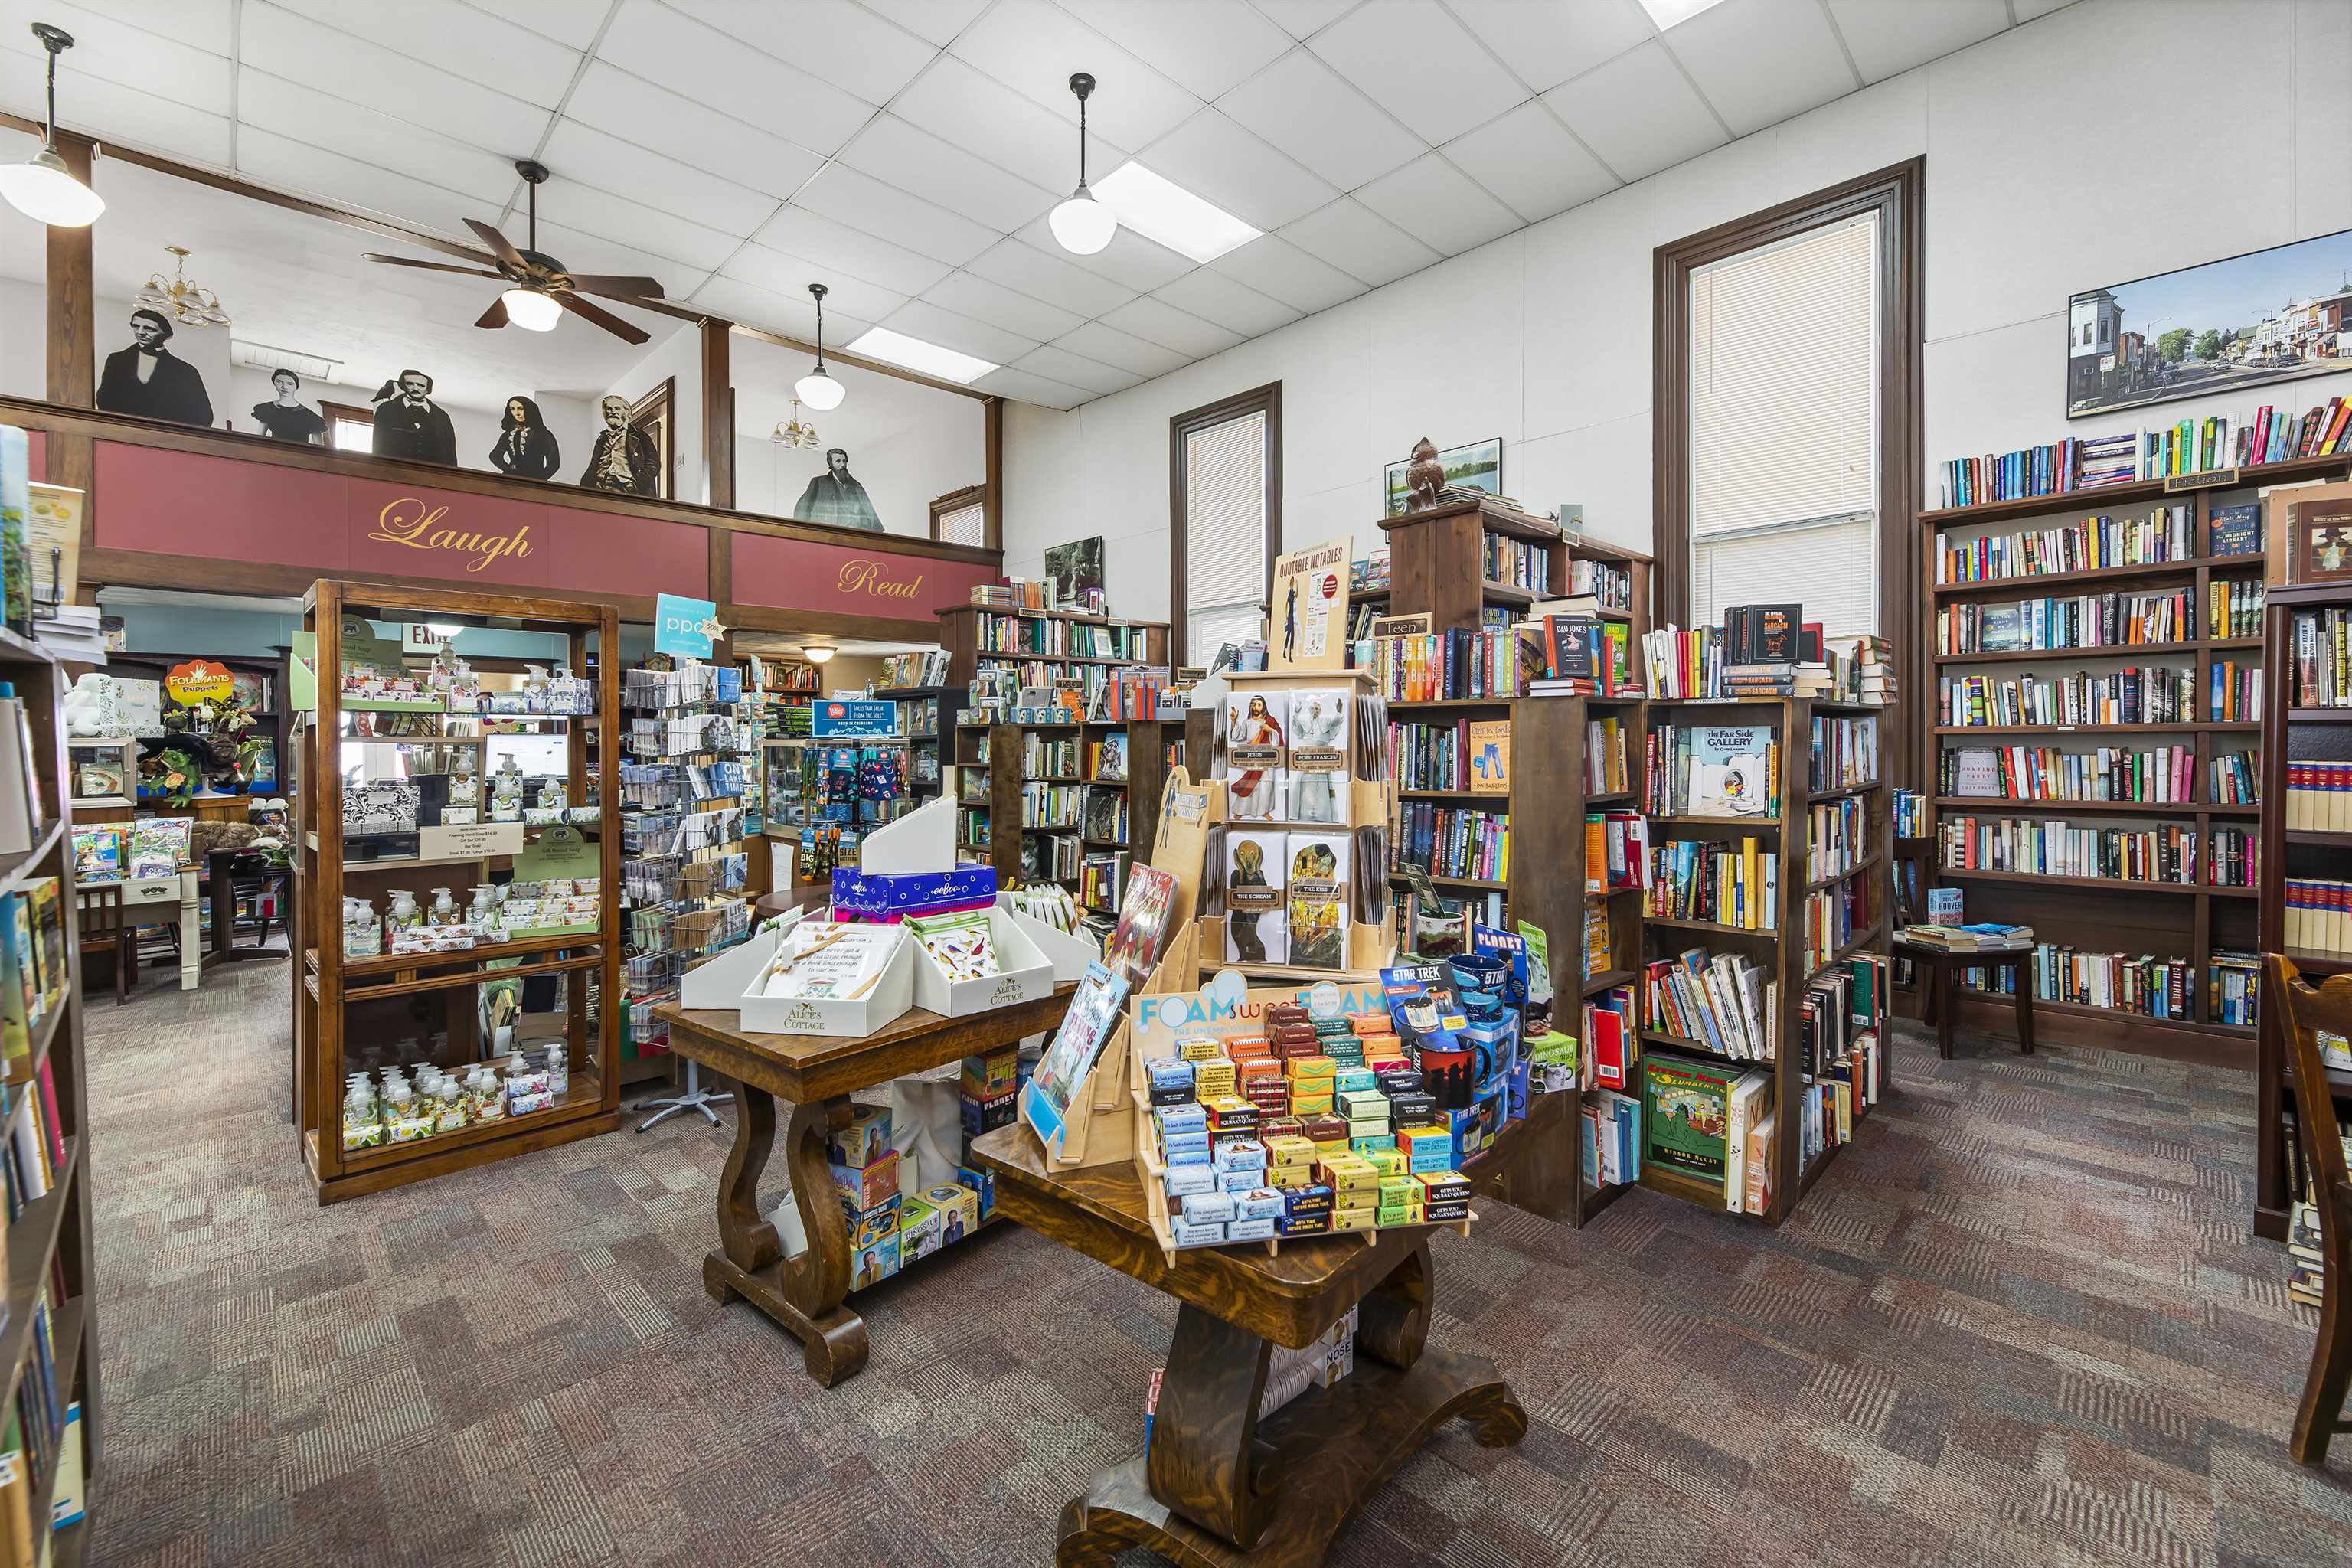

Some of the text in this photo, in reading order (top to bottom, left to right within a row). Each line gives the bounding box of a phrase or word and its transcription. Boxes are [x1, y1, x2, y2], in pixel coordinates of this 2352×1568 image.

[2174, 474, 2228, 488] Fiction
[368, 498, 533, 573] Laugh
[1280, 557, 1308, 579] QUOTABLE
[1310, 547, 1343, 568] NOTABLES
[838, 560, 922, 597] Read
[1485, 609, 1499, 619] DAVID
[707, 623, 719, 632] 50%
[1385, 622, 1416, 634] Teen
[1570, 625, 1586, 634] JOKES
[169, 672, 230, 686] FOLKMANIS
[182, 684, 218, 692] Puppets
[1707, 738, 1752, 746] GALLERY
[724, 764, 740, 774] ON
[724, 775, 743, 783] LAKE
[725, 783, 743, 792] TIME
[729, 901, 746, 916] LIFE
[1478, 933, 1522, 950] PLANET
[1393, 966, 1440, 982] STAR TREK
[1485, 971, 1505, 985] STAR
[994, 985, 1021, 995] ALICE'S
[991, 992, 1023, 1005] COTTAGE
[788, 1009, 822, 1019] ALICE'S
[1141, 996, 1235, 1027] FOAM
[784, 1019, 825, 1030] COTTAGE
[1535, 1045, 1574, 1060] DINOSAUR
[1559, 1051, 1573, 1061] mug
[986, 1063, 1017, 1080] TIME
[1656, 1074, 1726, 1093] SLUMBERLAN
[984, 1092, 1014, 1110] PLANET
[1456, 1106, 1480, 1122] STAR TREK
[1664, 1148, 1691, 1159] WINSOR
[906, 1217, 938, 1240] DINOSAUR
[1326, 1341, 1351, 1364] NOSE
